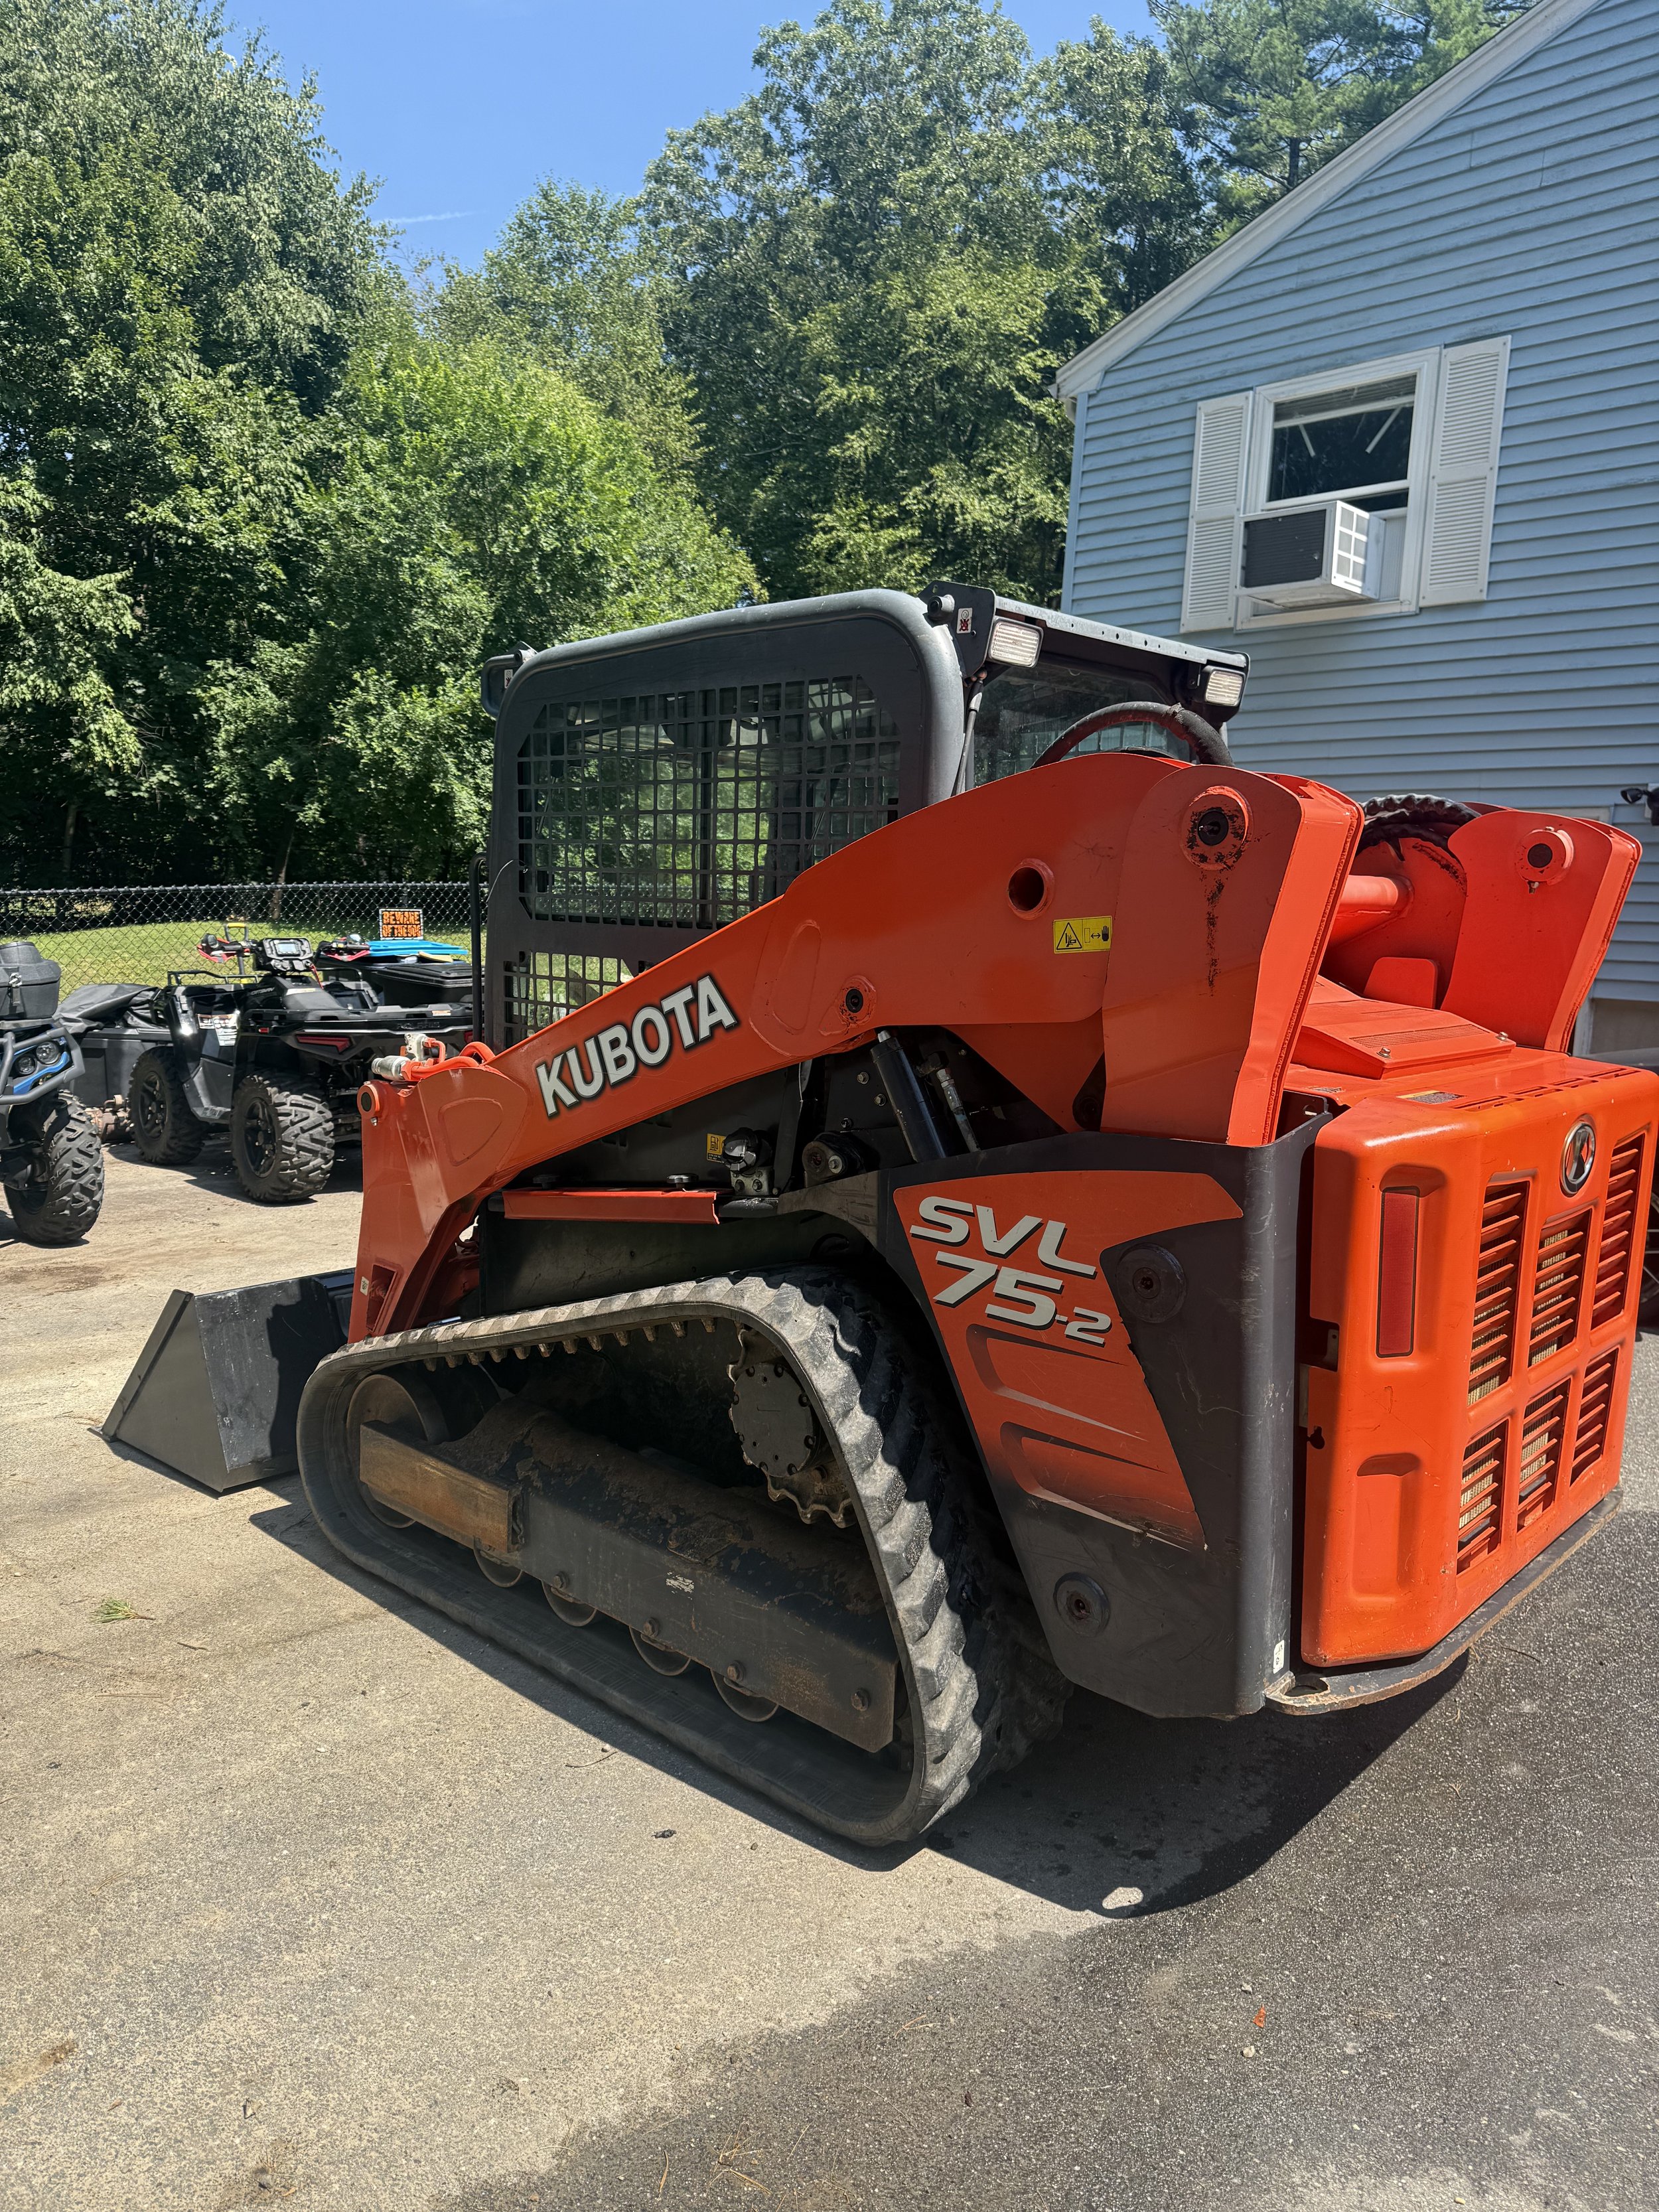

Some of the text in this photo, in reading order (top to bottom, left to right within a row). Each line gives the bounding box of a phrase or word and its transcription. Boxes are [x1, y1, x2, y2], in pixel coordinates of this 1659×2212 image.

[383, 911, 420, 924] BEWARE
[536, 974, 738, 1117] KUBOTA
[909, 1195, 1098, 1280] SVL
